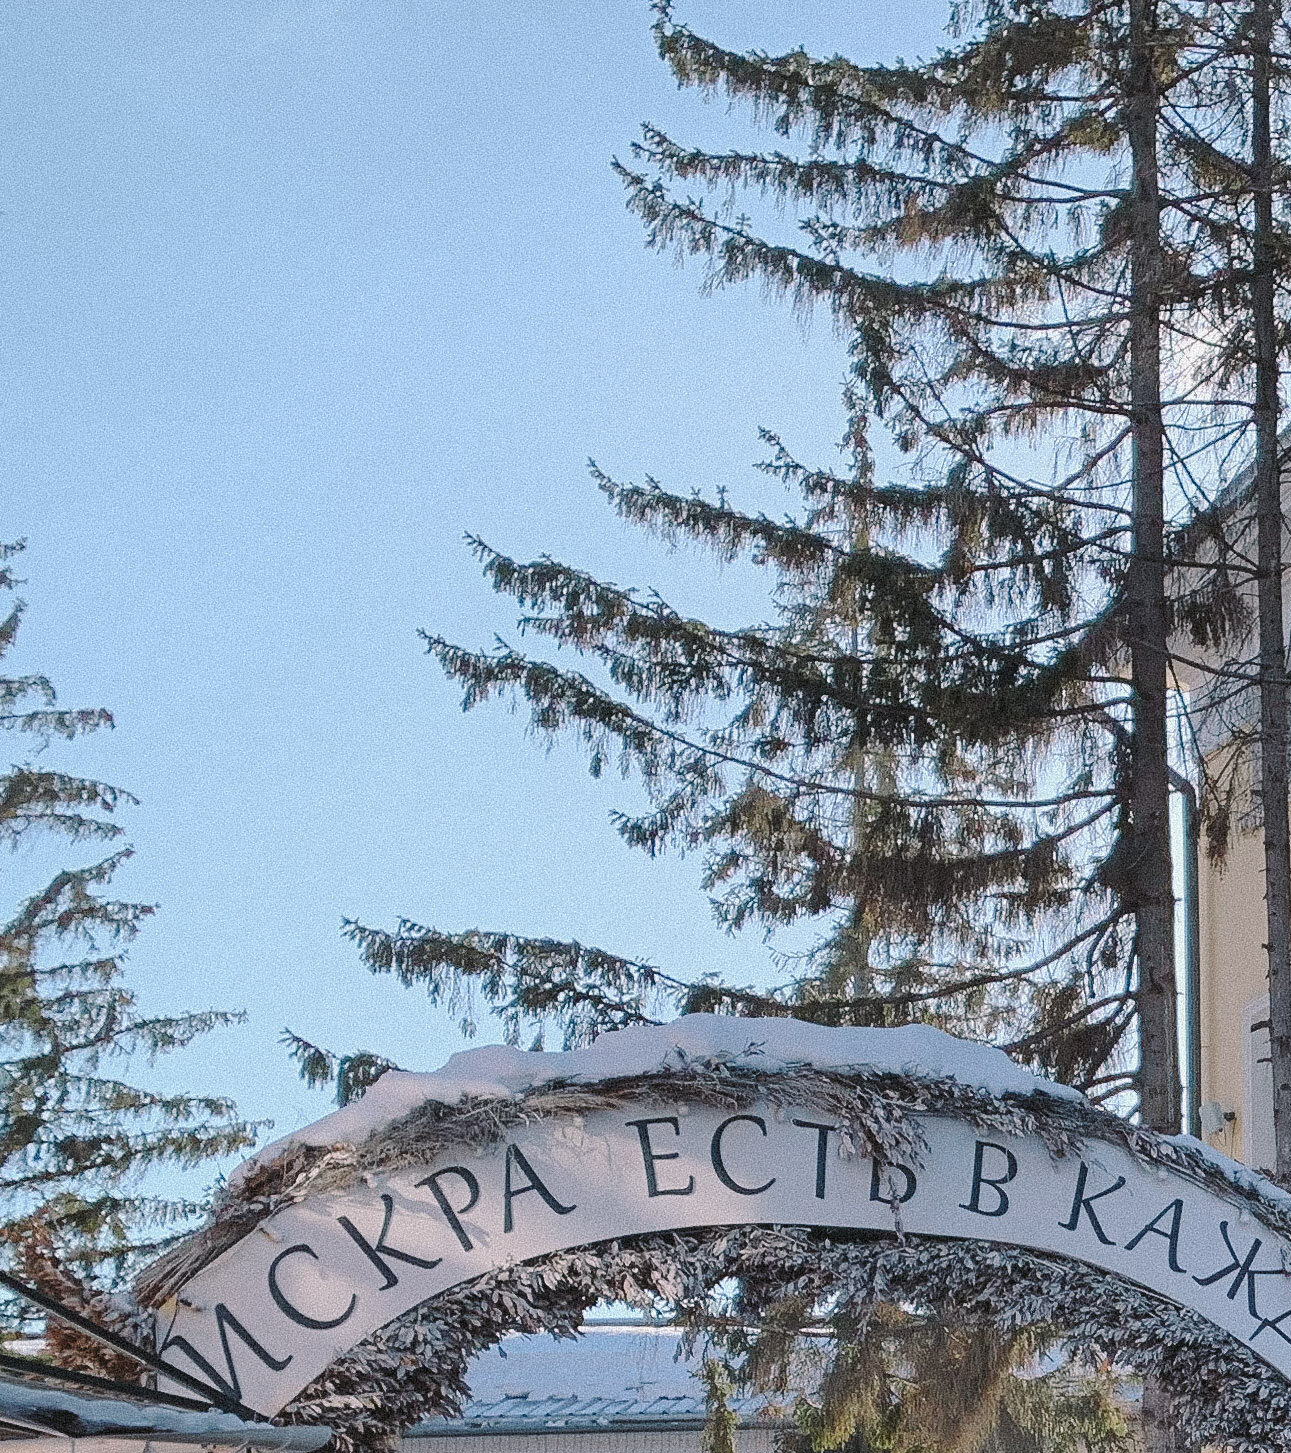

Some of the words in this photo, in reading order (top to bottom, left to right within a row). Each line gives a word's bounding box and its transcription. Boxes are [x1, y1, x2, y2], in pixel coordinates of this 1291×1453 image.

[160, 1143, 577, 1401] ИСКРА
[626, 1115, 917, 1205] ЕСТЬ
[958, 1139, 1018, 1217] В
